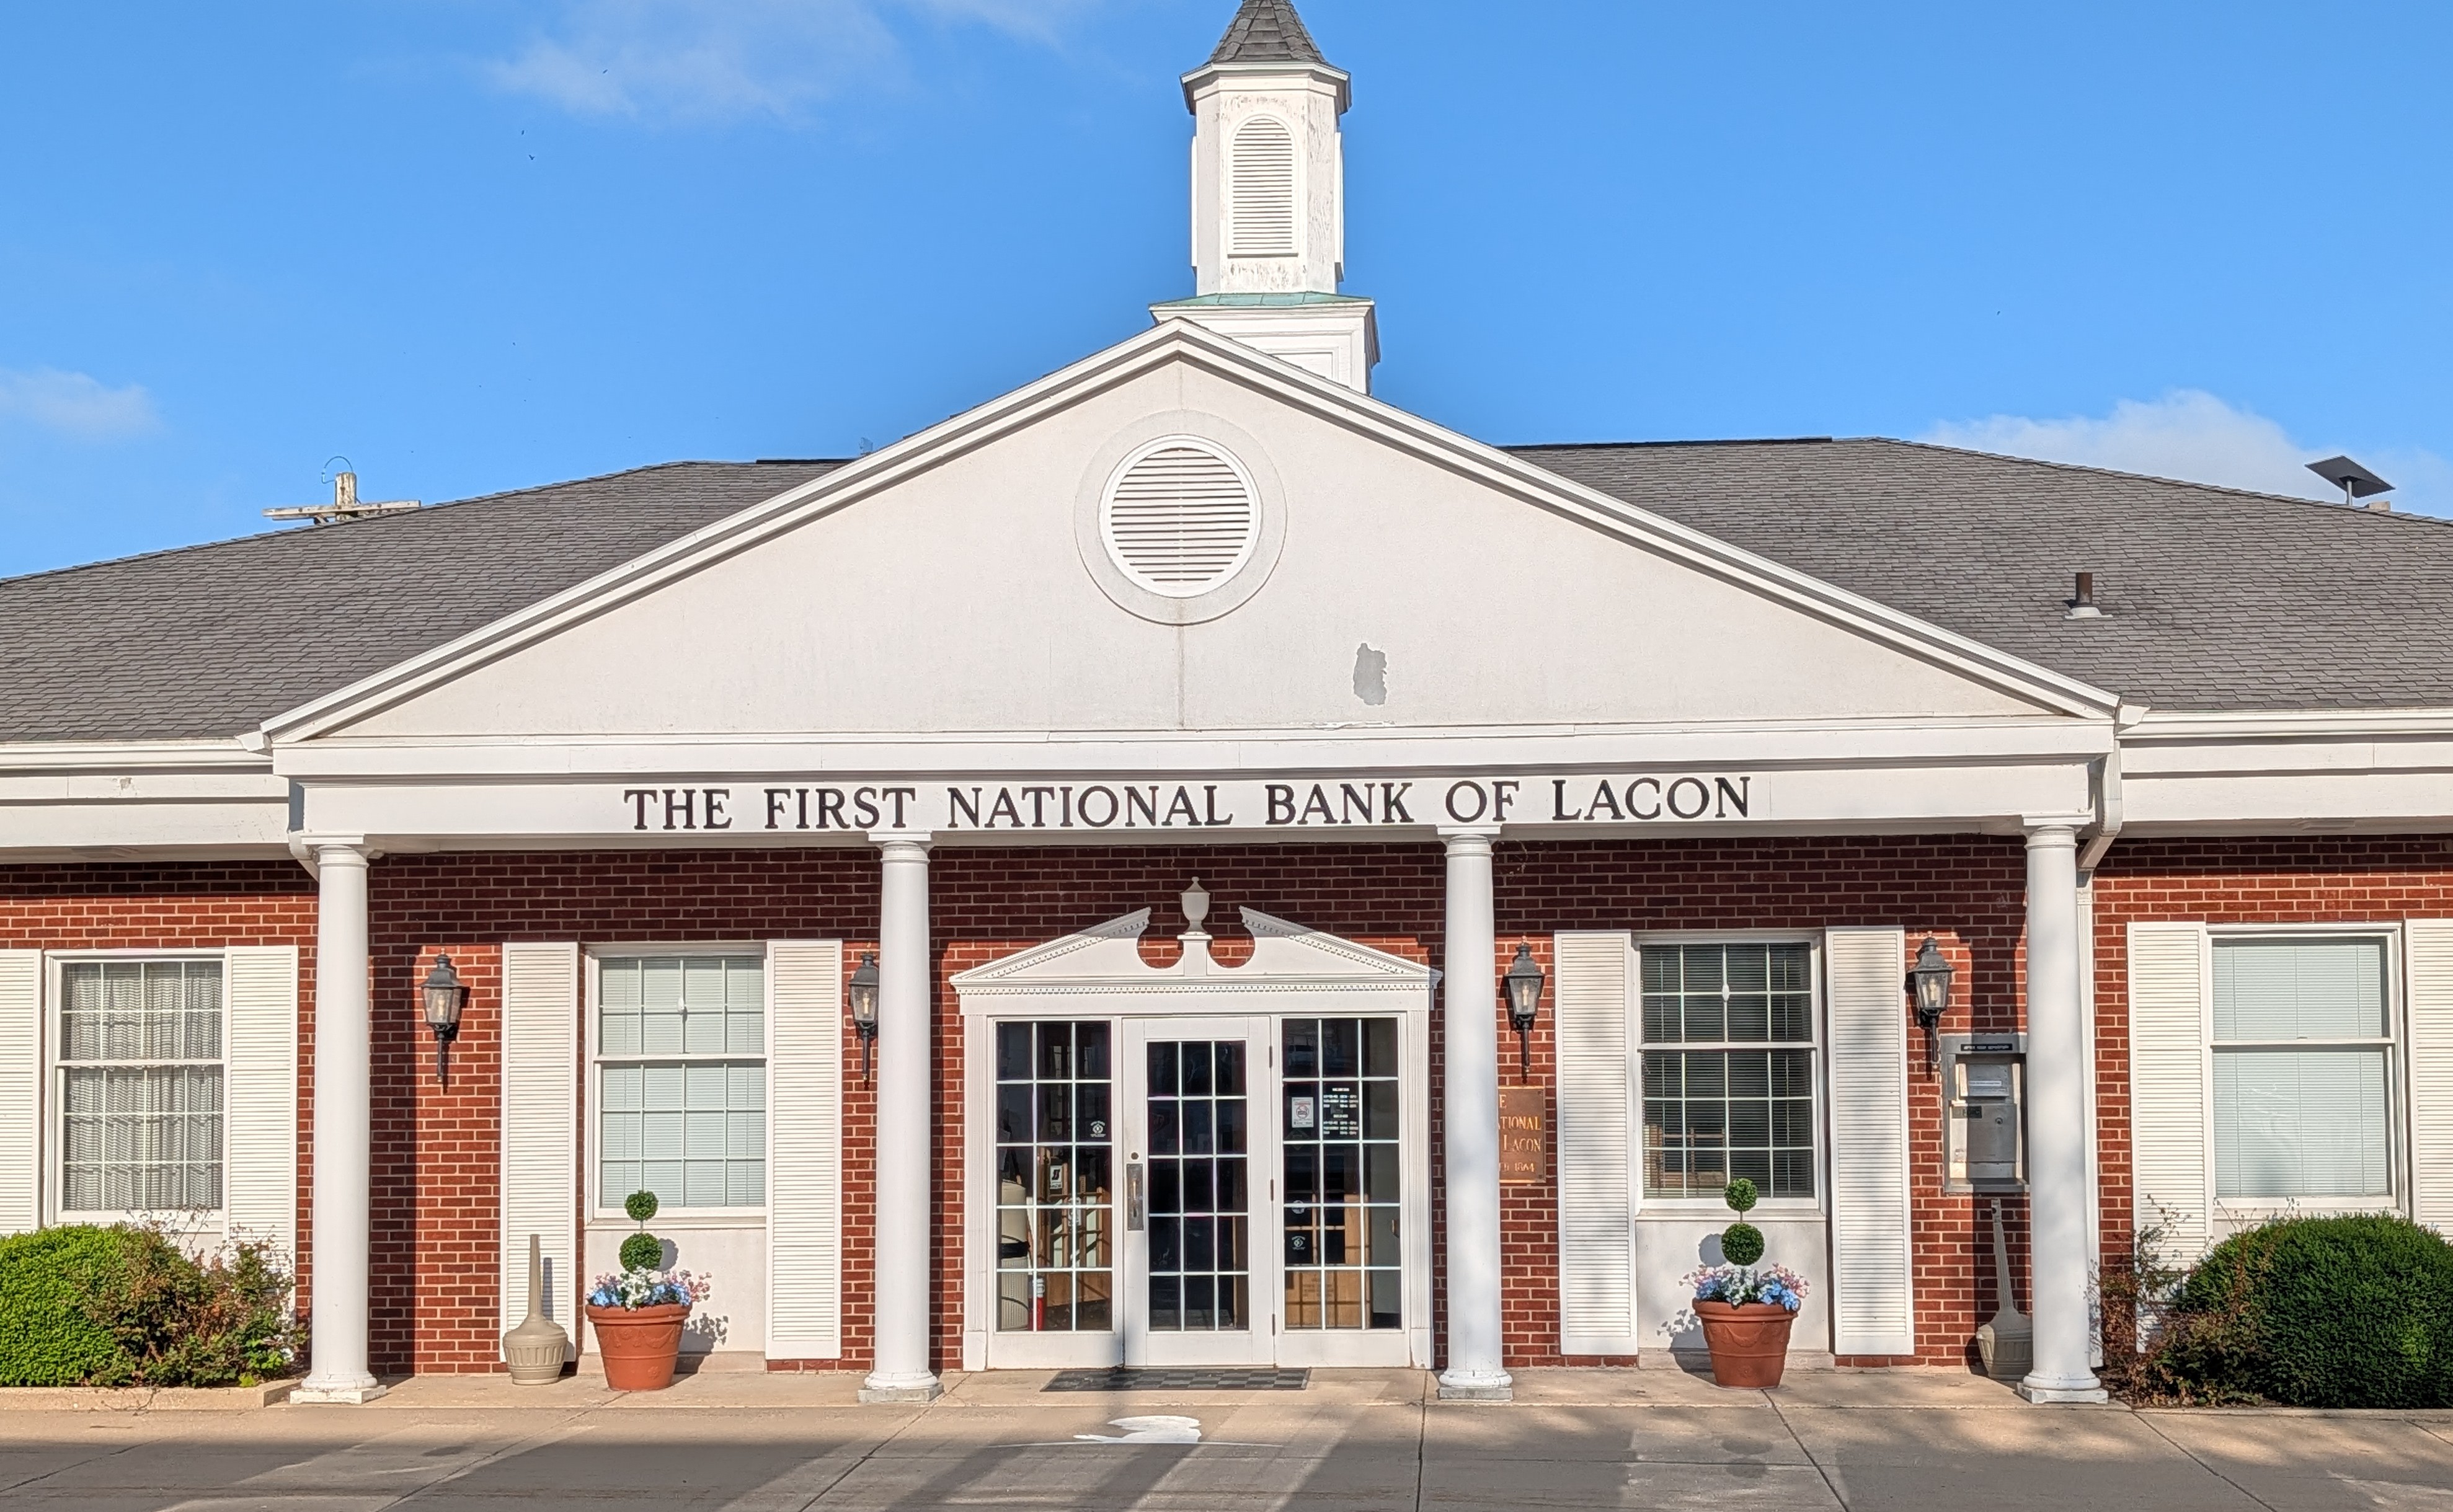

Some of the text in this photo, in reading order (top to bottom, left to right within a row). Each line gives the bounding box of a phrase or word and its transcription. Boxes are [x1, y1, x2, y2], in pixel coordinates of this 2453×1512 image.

[624, 776, 1750, 830] THE FIRST NATIONAL BANK OF LACON
